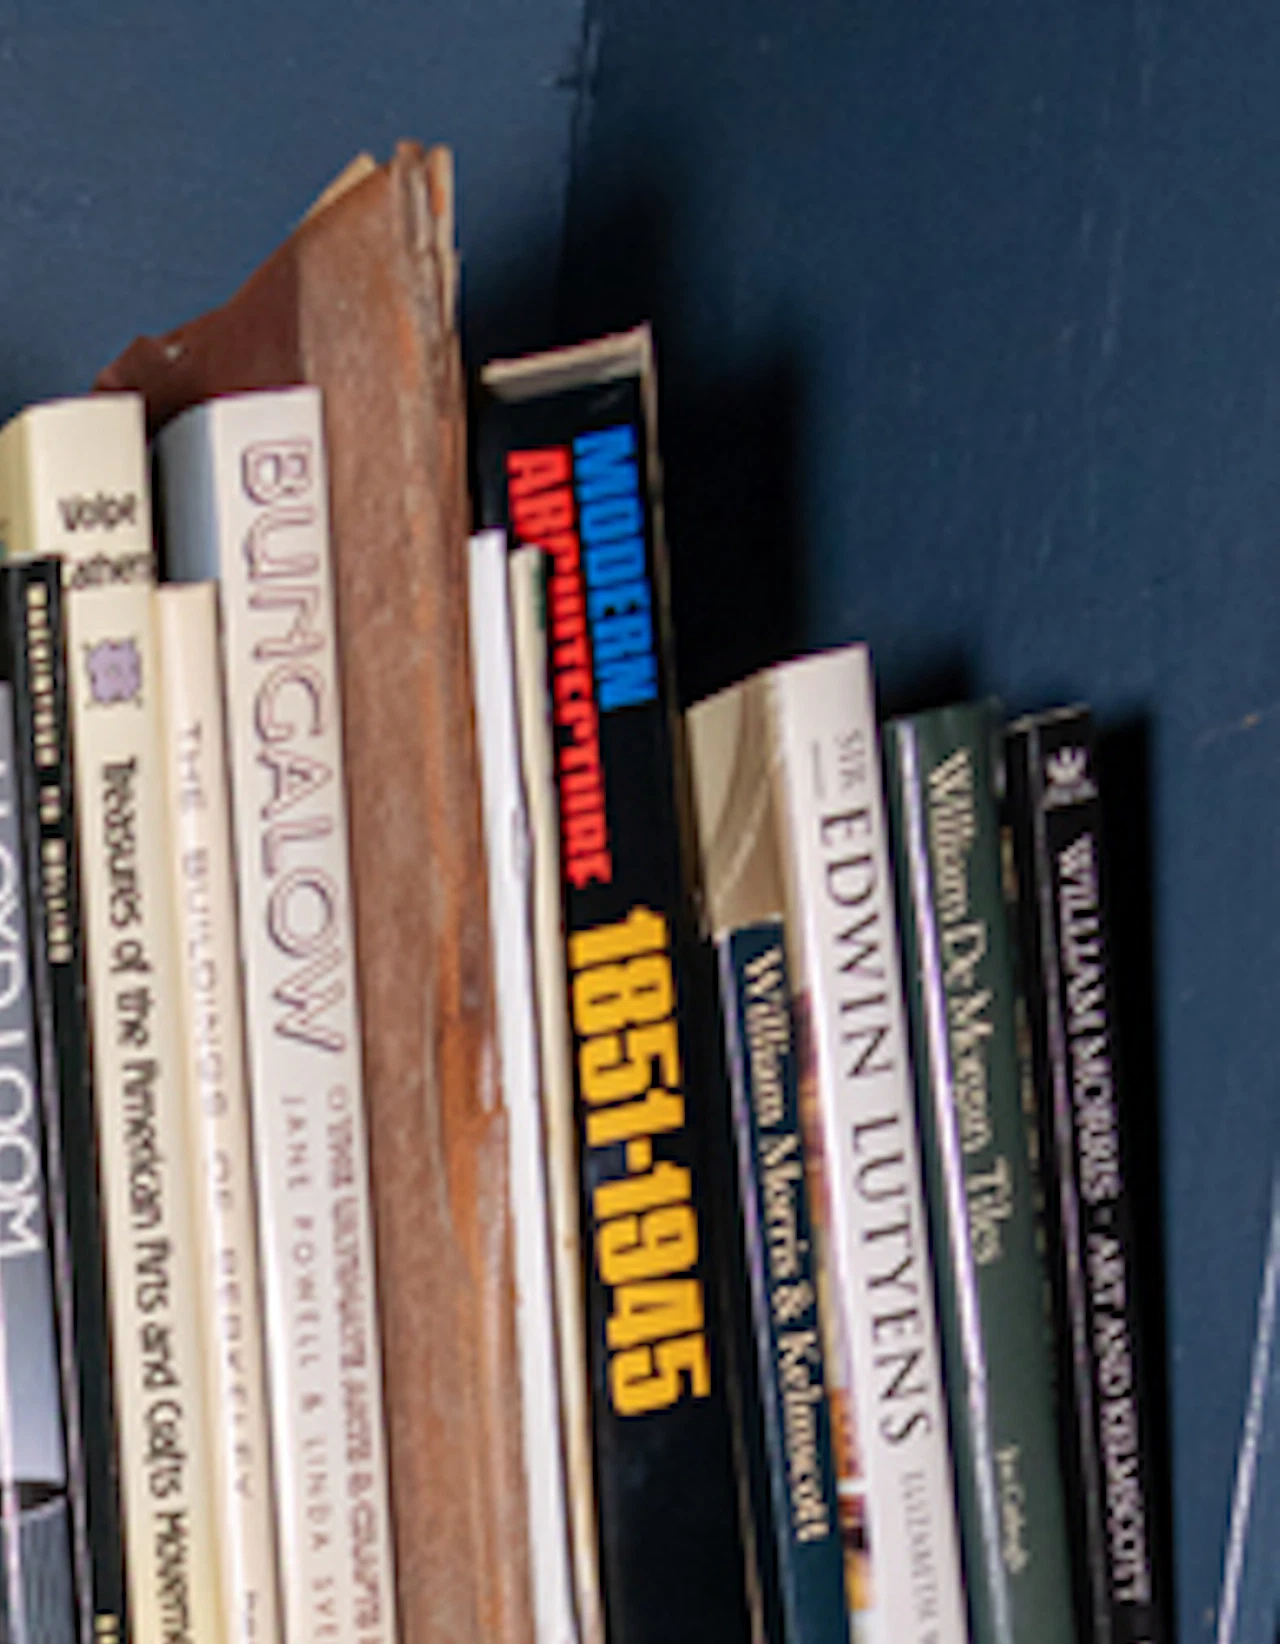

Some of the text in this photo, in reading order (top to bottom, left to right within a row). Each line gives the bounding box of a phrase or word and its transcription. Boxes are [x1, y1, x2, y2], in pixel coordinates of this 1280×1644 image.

[572, 425, 659, 708] MODERN
[239, 438, 350, 1058] BUNGALOW
[99, 757, 150, 929] Treasures
[110, 939, 154, 977] of
[117, 988, 157, 1049] the
[926, 749, 1015, 1265] William De Morgan Tiles
[122, 1059, 171, 1231] American
[280, 1094, 314, 1191] JANE
[567, 907, 712, 1415] 1851-1945
[820, 731, 930, 1447] SIR EDWIN LUTYENS
[135, 1240, 177, 1315] Arts
[287, 1214, 324, 1368] POWELL
[743, 949, 840, 1545] William Morris & Kelmscott
[1055, 839, 1159, 1608] WILLIAM MORRIS ART AND KELMSCOTT
[139, 1322, 179, 1389] and
[139, 1400, 189, 1500] Crafts
[301, 1437, 335, 1552] LINDA
